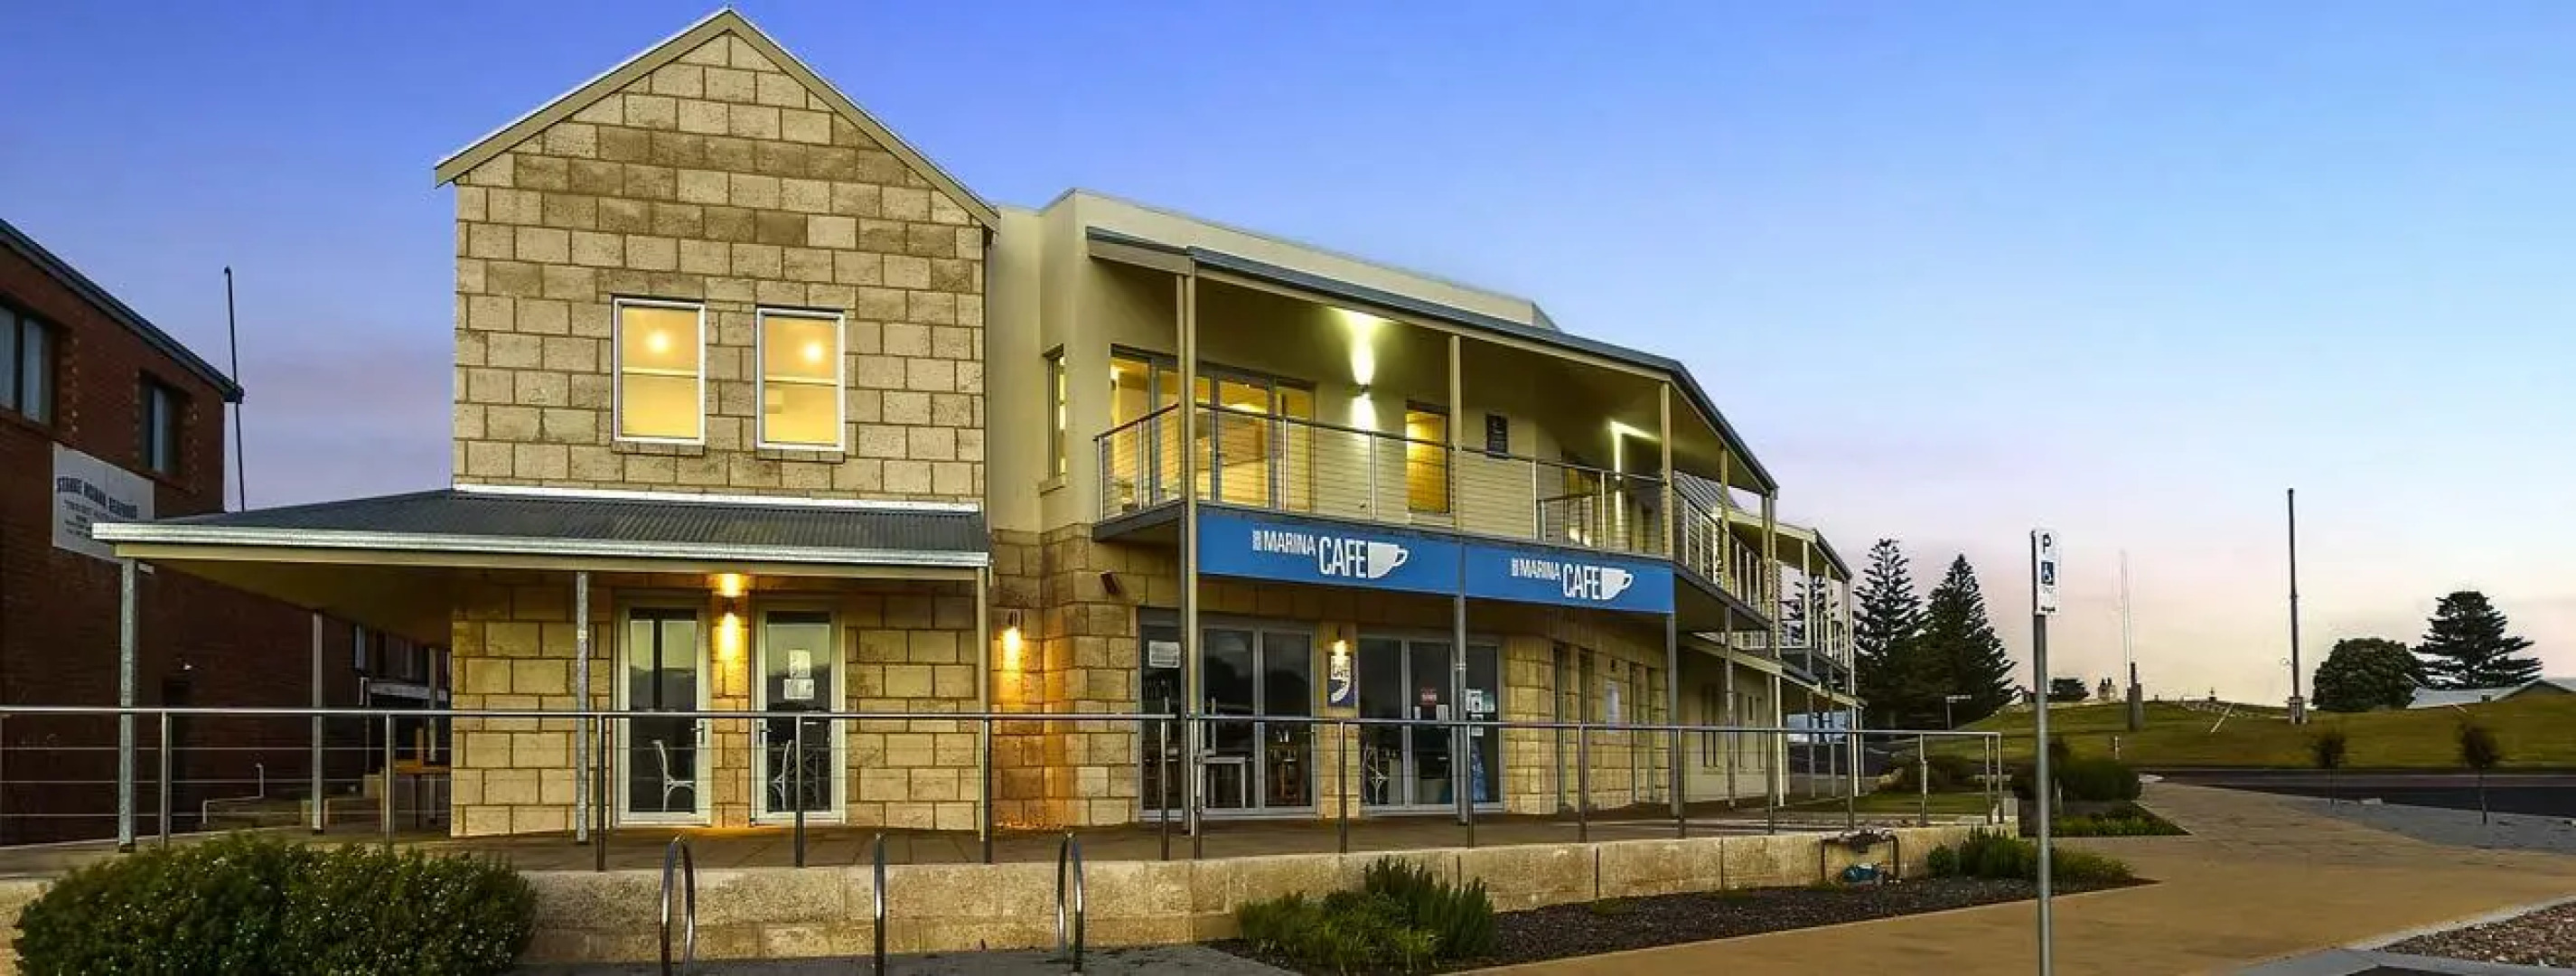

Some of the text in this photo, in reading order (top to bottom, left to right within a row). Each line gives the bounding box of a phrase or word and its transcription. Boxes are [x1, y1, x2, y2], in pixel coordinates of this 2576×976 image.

[1264, 530, 1316, 556] MARINA
[1318, 536, 1366, 578] CAFE
[2042, 532, 2052, 554] P
[1520, 558, 1561, 580] MARINA
[1562, 563, 1600, 599] CAFE
